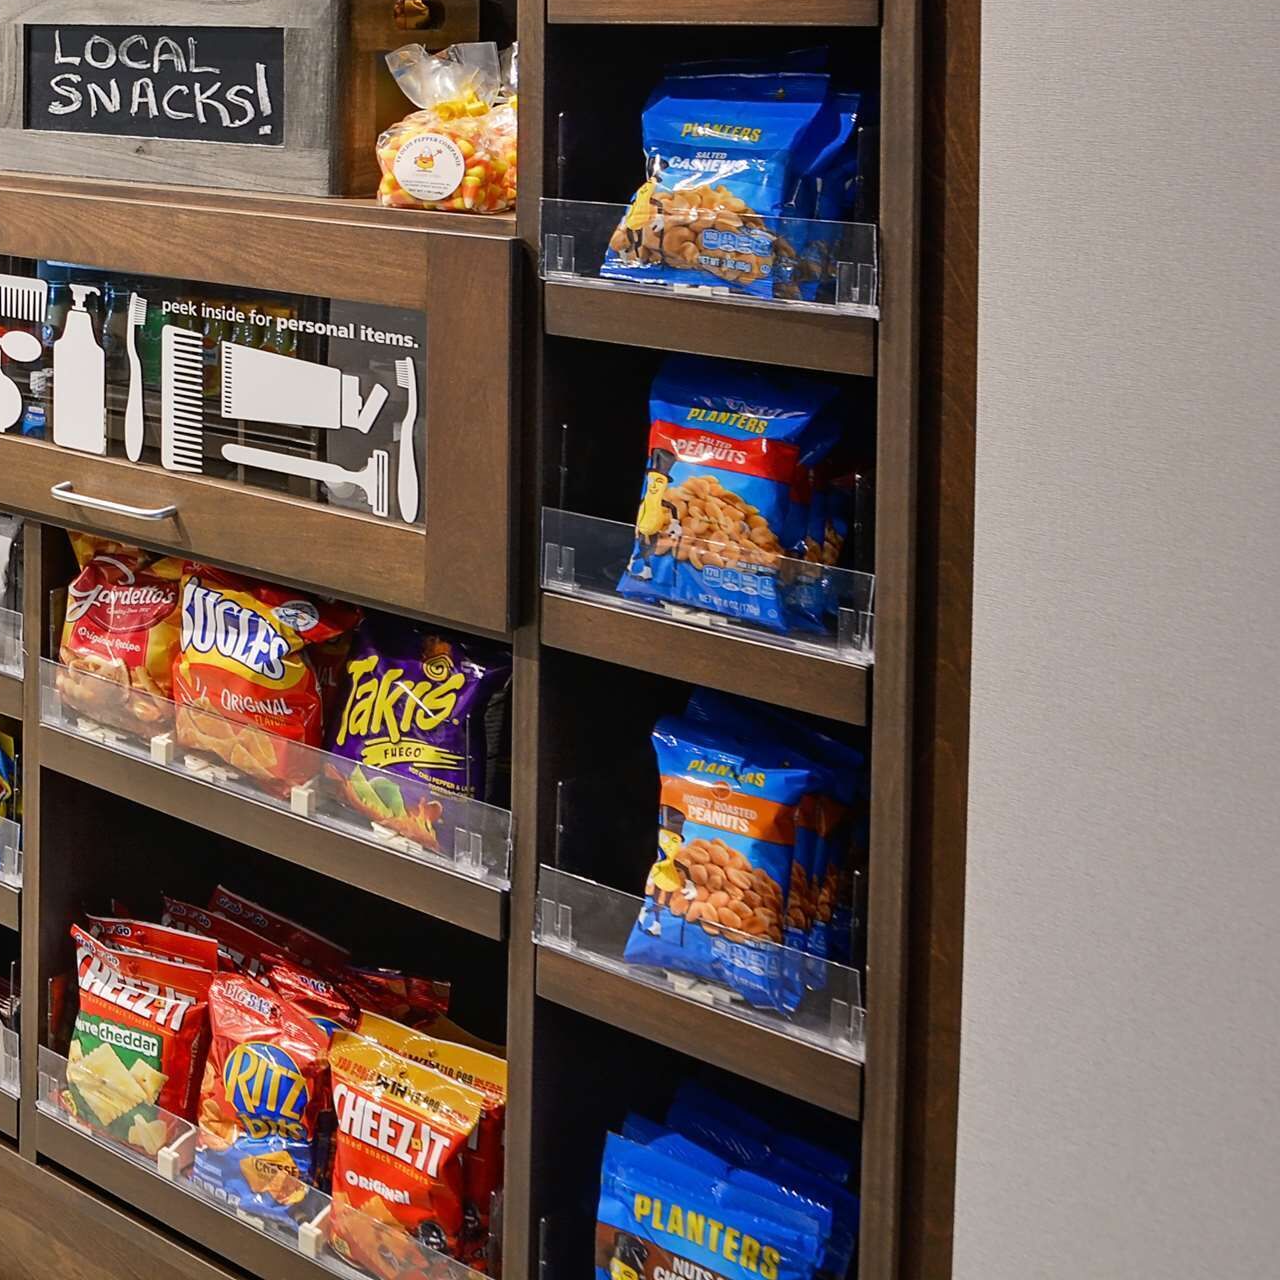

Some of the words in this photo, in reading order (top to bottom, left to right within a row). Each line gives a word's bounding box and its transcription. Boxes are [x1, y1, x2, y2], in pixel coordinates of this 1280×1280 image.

[54, 29, 220, 74] LOCAL
[49, 62, 273, 136] SNACKS!
[696, 151, 727, 160] SALTED
[161, 300, 197, 317] peek
[201, 303, 245, 324] inside
[248, 308, 273, 327] for
[276, 315, 357, 343] personal
[360, 323, 420, 348] items.
[687, 407, 769, 434] PLANTERS
[675, 438, 748, 464] PEANUTS
[698, 434, 732, 449] SALTED
[78, 626, 114, 647] Original
[115, 638, 141, 652] Recipe
[221, 689, 293, 715] ORIGINAL
[337, 656, 466, 746] Takis
[384, 746, 424, 761] FUEGO
[687, 804, 749, 832] PEANUTS
[714, 800, 758, 820] ROASTED
[99, 1024, 159, 1052] cheddar
[226, 1048, 309, 1119] RITZ
[239, 1112, 306, 1140] bits
[633, 1193, 782, 1280] PLANTERS
